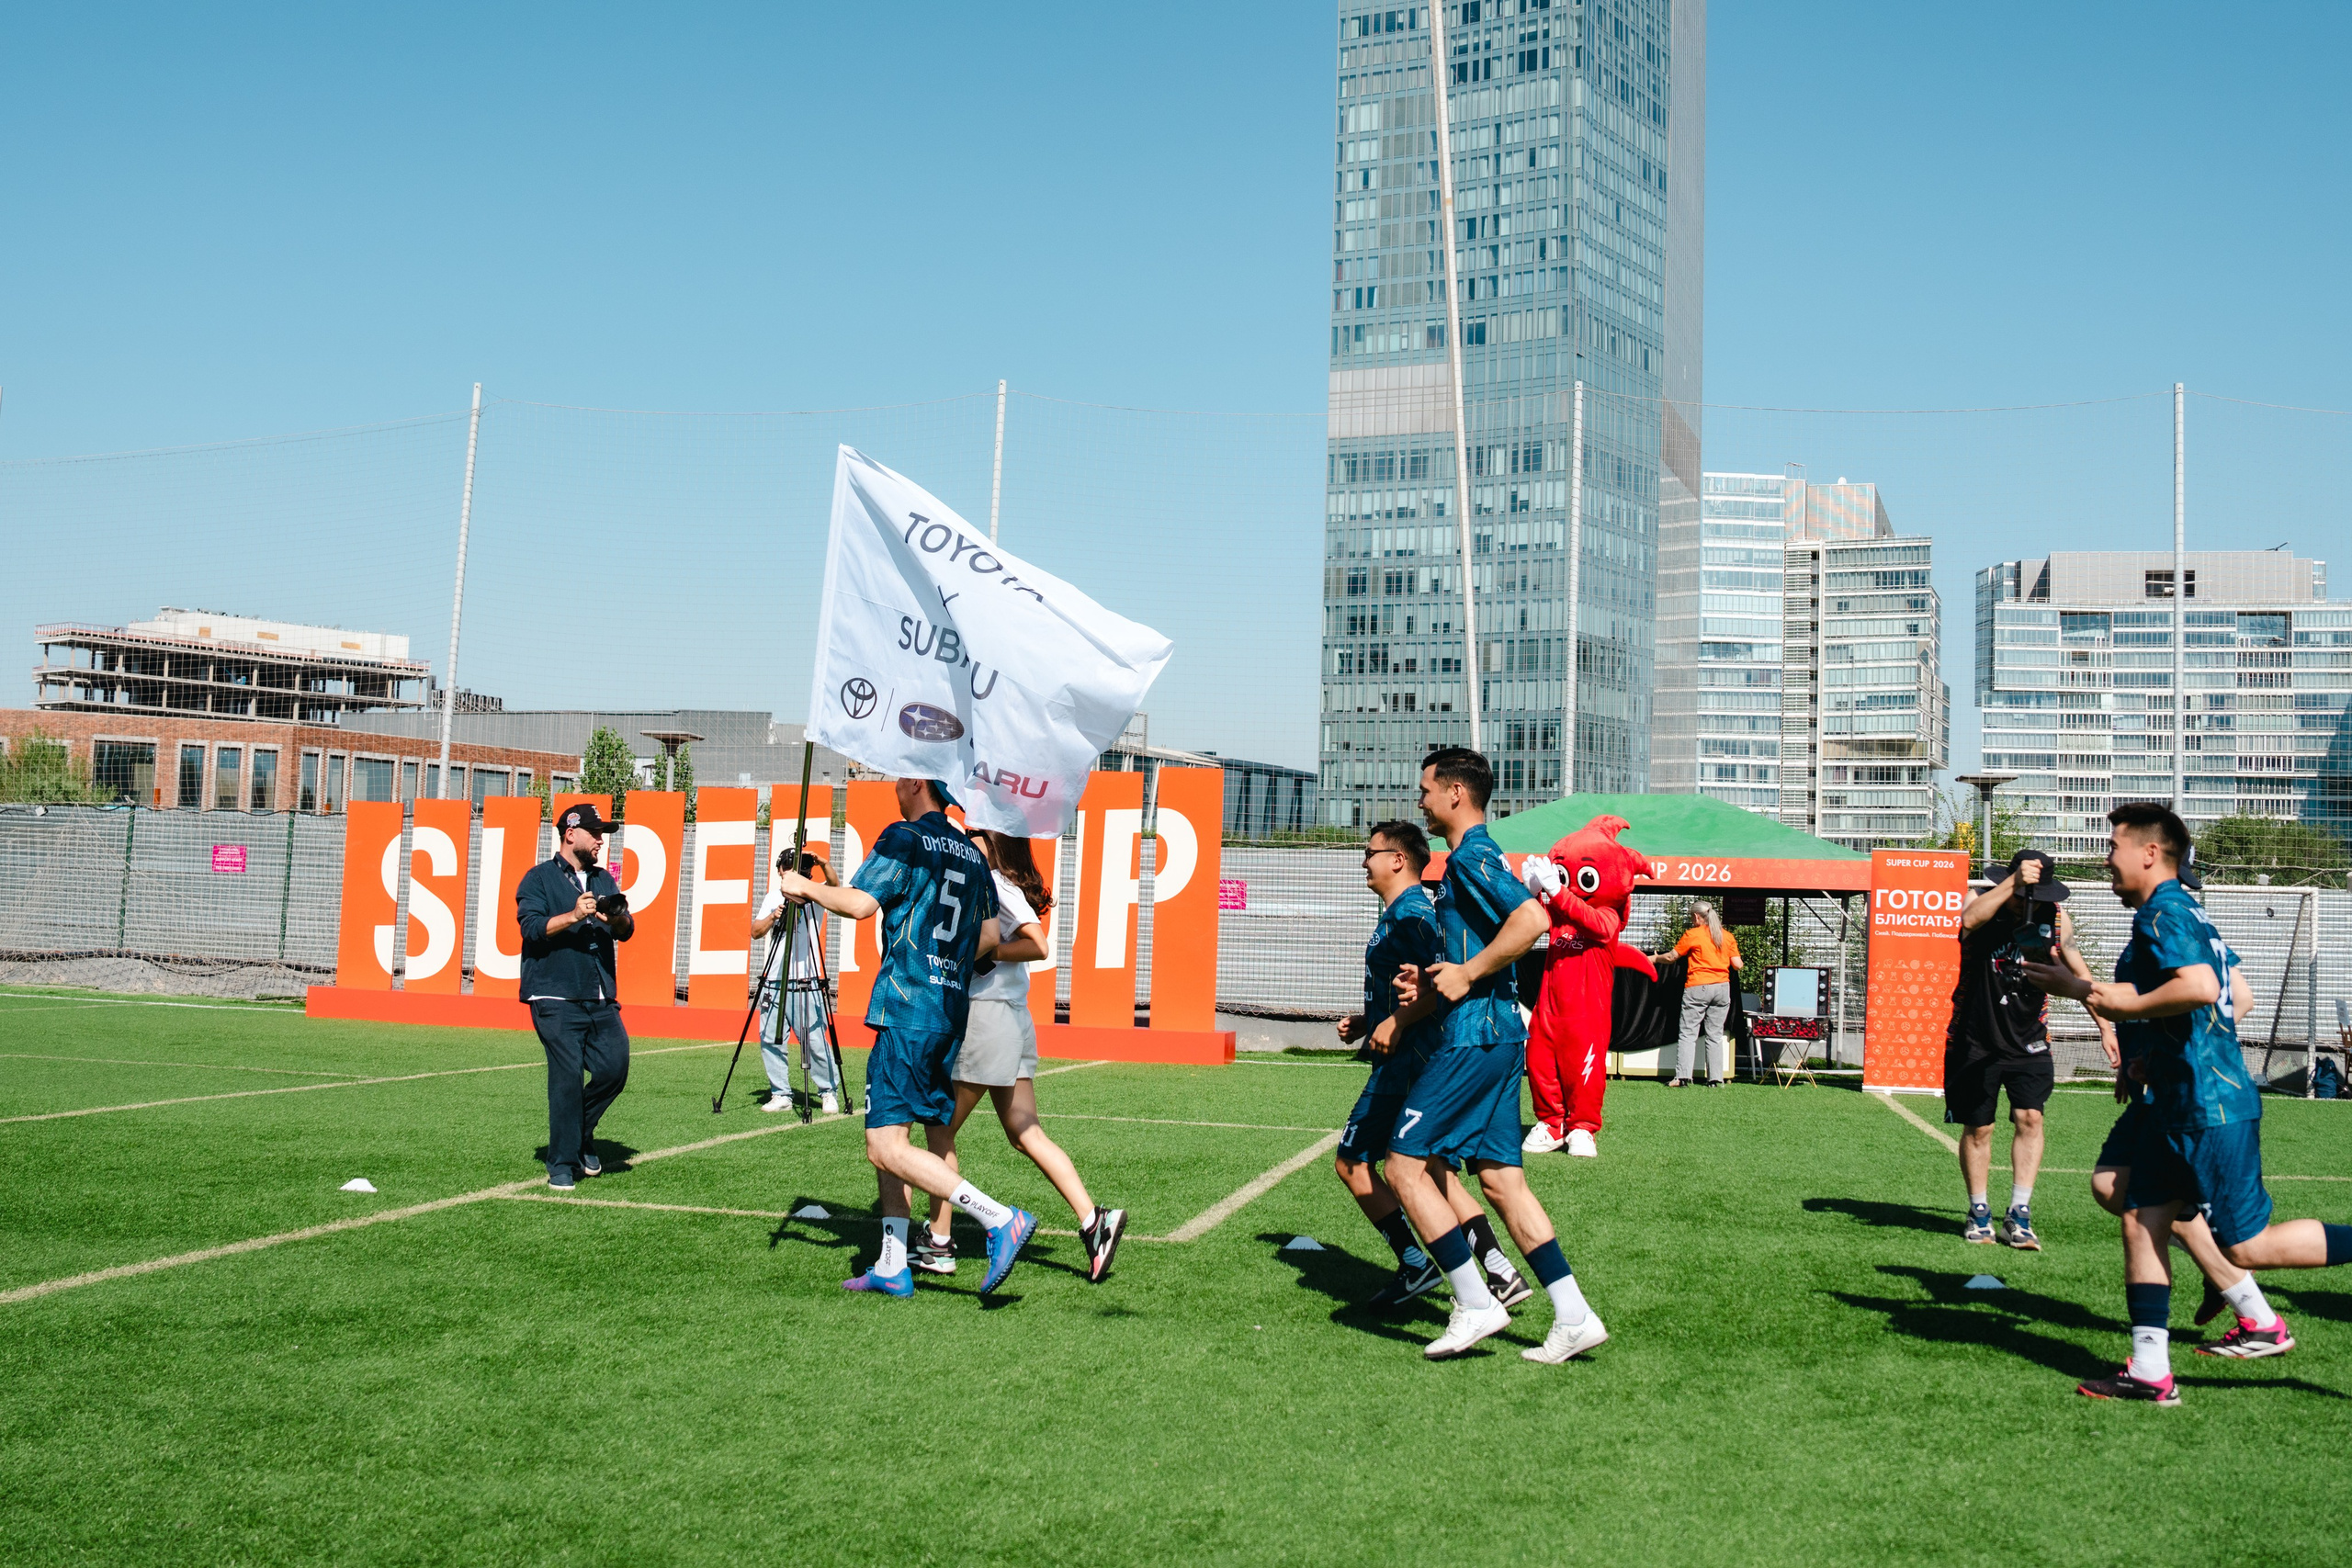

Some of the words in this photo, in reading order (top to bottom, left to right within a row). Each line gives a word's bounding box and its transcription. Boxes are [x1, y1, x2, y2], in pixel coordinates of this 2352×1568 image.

[1678, 863, 1732, 882] 2026
[1885, 858, 1911, 867] SUPER
[1912, 859, 1930, 867] CUP
[1932, 860, 1955, 869] 2026
[933, 868, 966, 942] 5
[1875, 888, 1963, 911] ГОТОВ
[1874, 913, 1962, 928] БЛИСТАТЬ?
[926, 953, 957, 973] TOYOTA
[929, 975, 962, 990] SUBARU
[1397, 1108, 1423, 1139] 7
[970, 1201, 1001, 1218] PLAYOFF
